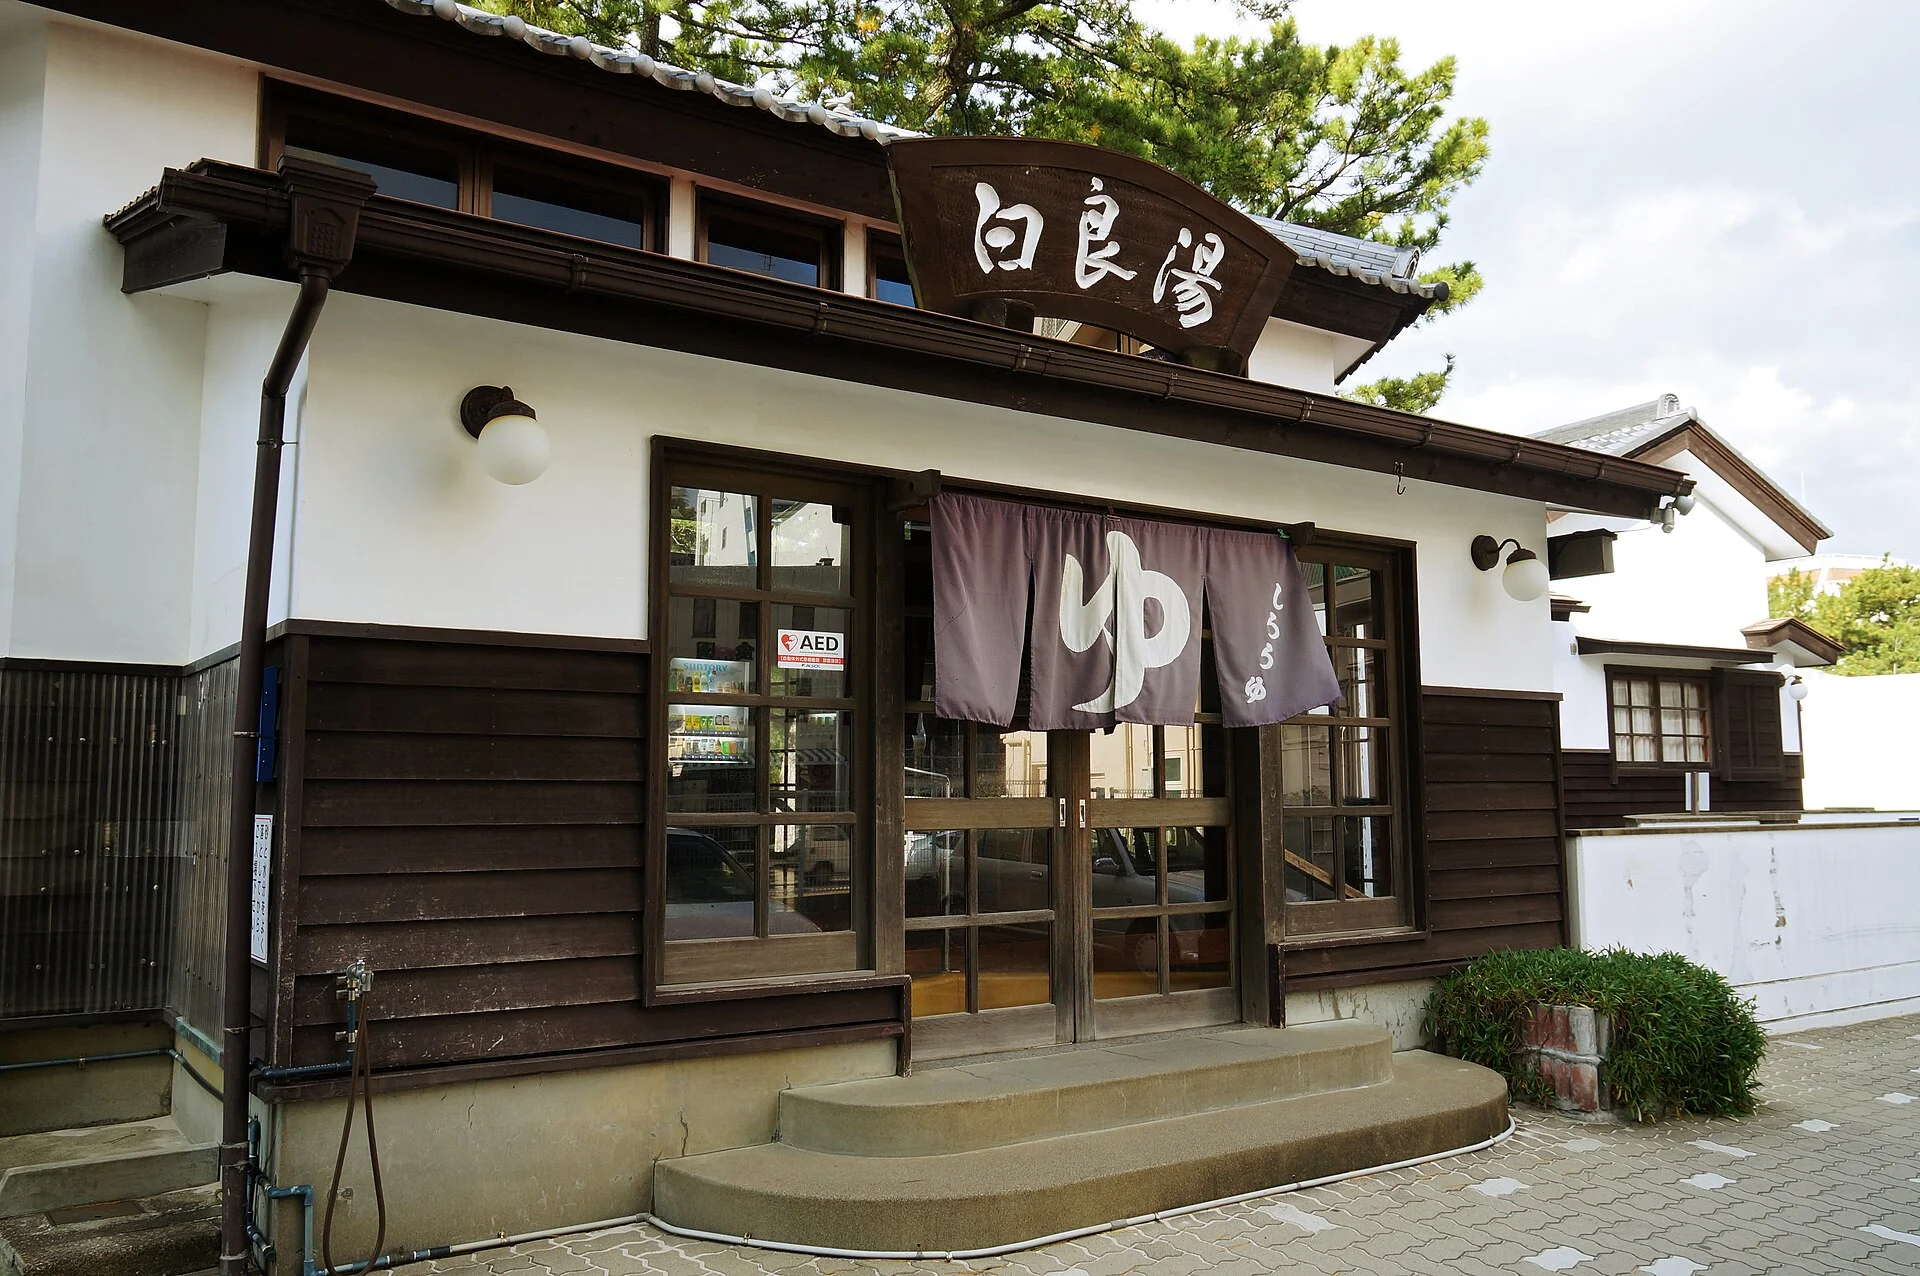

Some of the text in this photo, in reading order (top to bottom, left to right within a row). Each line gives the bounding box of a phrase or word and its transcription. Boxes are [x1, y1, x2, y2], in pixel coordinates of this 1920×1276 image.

[974, 176, 1225, 328] 白良湯
[799, 634, 839, 651] AED
[1060, 530, 1191, 714] ゆ
